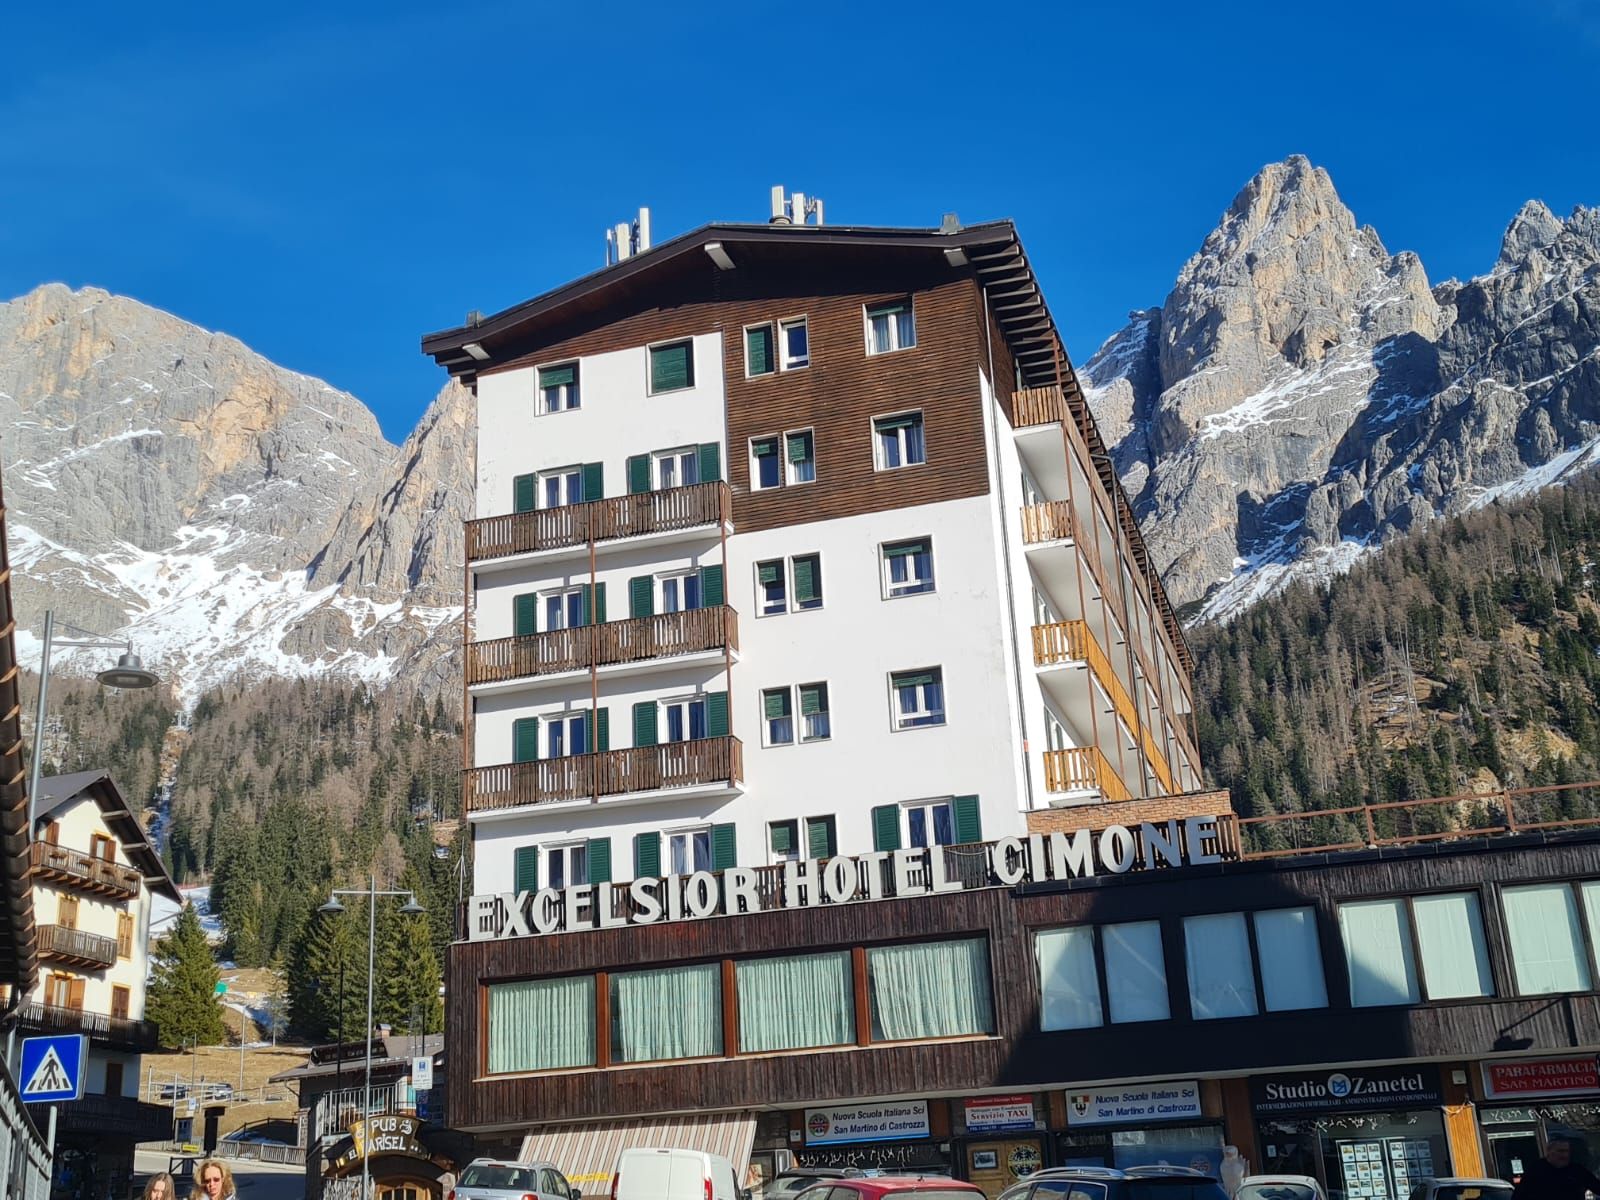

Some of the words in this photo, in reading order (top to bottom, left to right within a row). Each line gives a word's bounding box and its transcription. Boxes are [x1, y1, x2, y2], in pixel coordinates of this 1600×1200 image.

[468, 866, 761, 941] EXCELSIOR
[784, 844, 964, 909] HOTEL
[992, 815, 1223, 885] CIMONE
[1496, 1062, 1597, 1077] PARAFARMACIA
[1266, 1080, 1326, 1100] Studio
[1351, 1073, 1424, 1095] Zanetel
[1500, 1080, 1527, 1089] SAN
[1532, 1075, 1596, 1088] MARTINO
[1095, 1095, 1119, 1104] Nuova
[1122, 1093, 1148, 1102] Scuola
[1151, 1090, 1178, 1100] Italiana
[1182, 1088, 1195, 1098] Sci
[832, 1111, 855, 1121] Nuova
[857, 1109, 882, 1120] Scuola
[883, 1107, 911, 1118] Italiana
[912, 1105, 925, 1115] Sci
[970, 1111, 1005, 1120] Servizio
[1098, 1108, 1113, 1118] San
[1116, 1106, 1144, 1116] Martino
[1147, 1104, 1155, 1114] di
[1157, 1103, 1196, 1113] Castrozza
[371, 1118, 397, 1132] PUB
[834, 1124, 848, 1135] San
[849, 1122, 878, 1133] Martino
[879, 1122, 887, 1131] di
[888, 1120, 925, 1130] Castrozza
